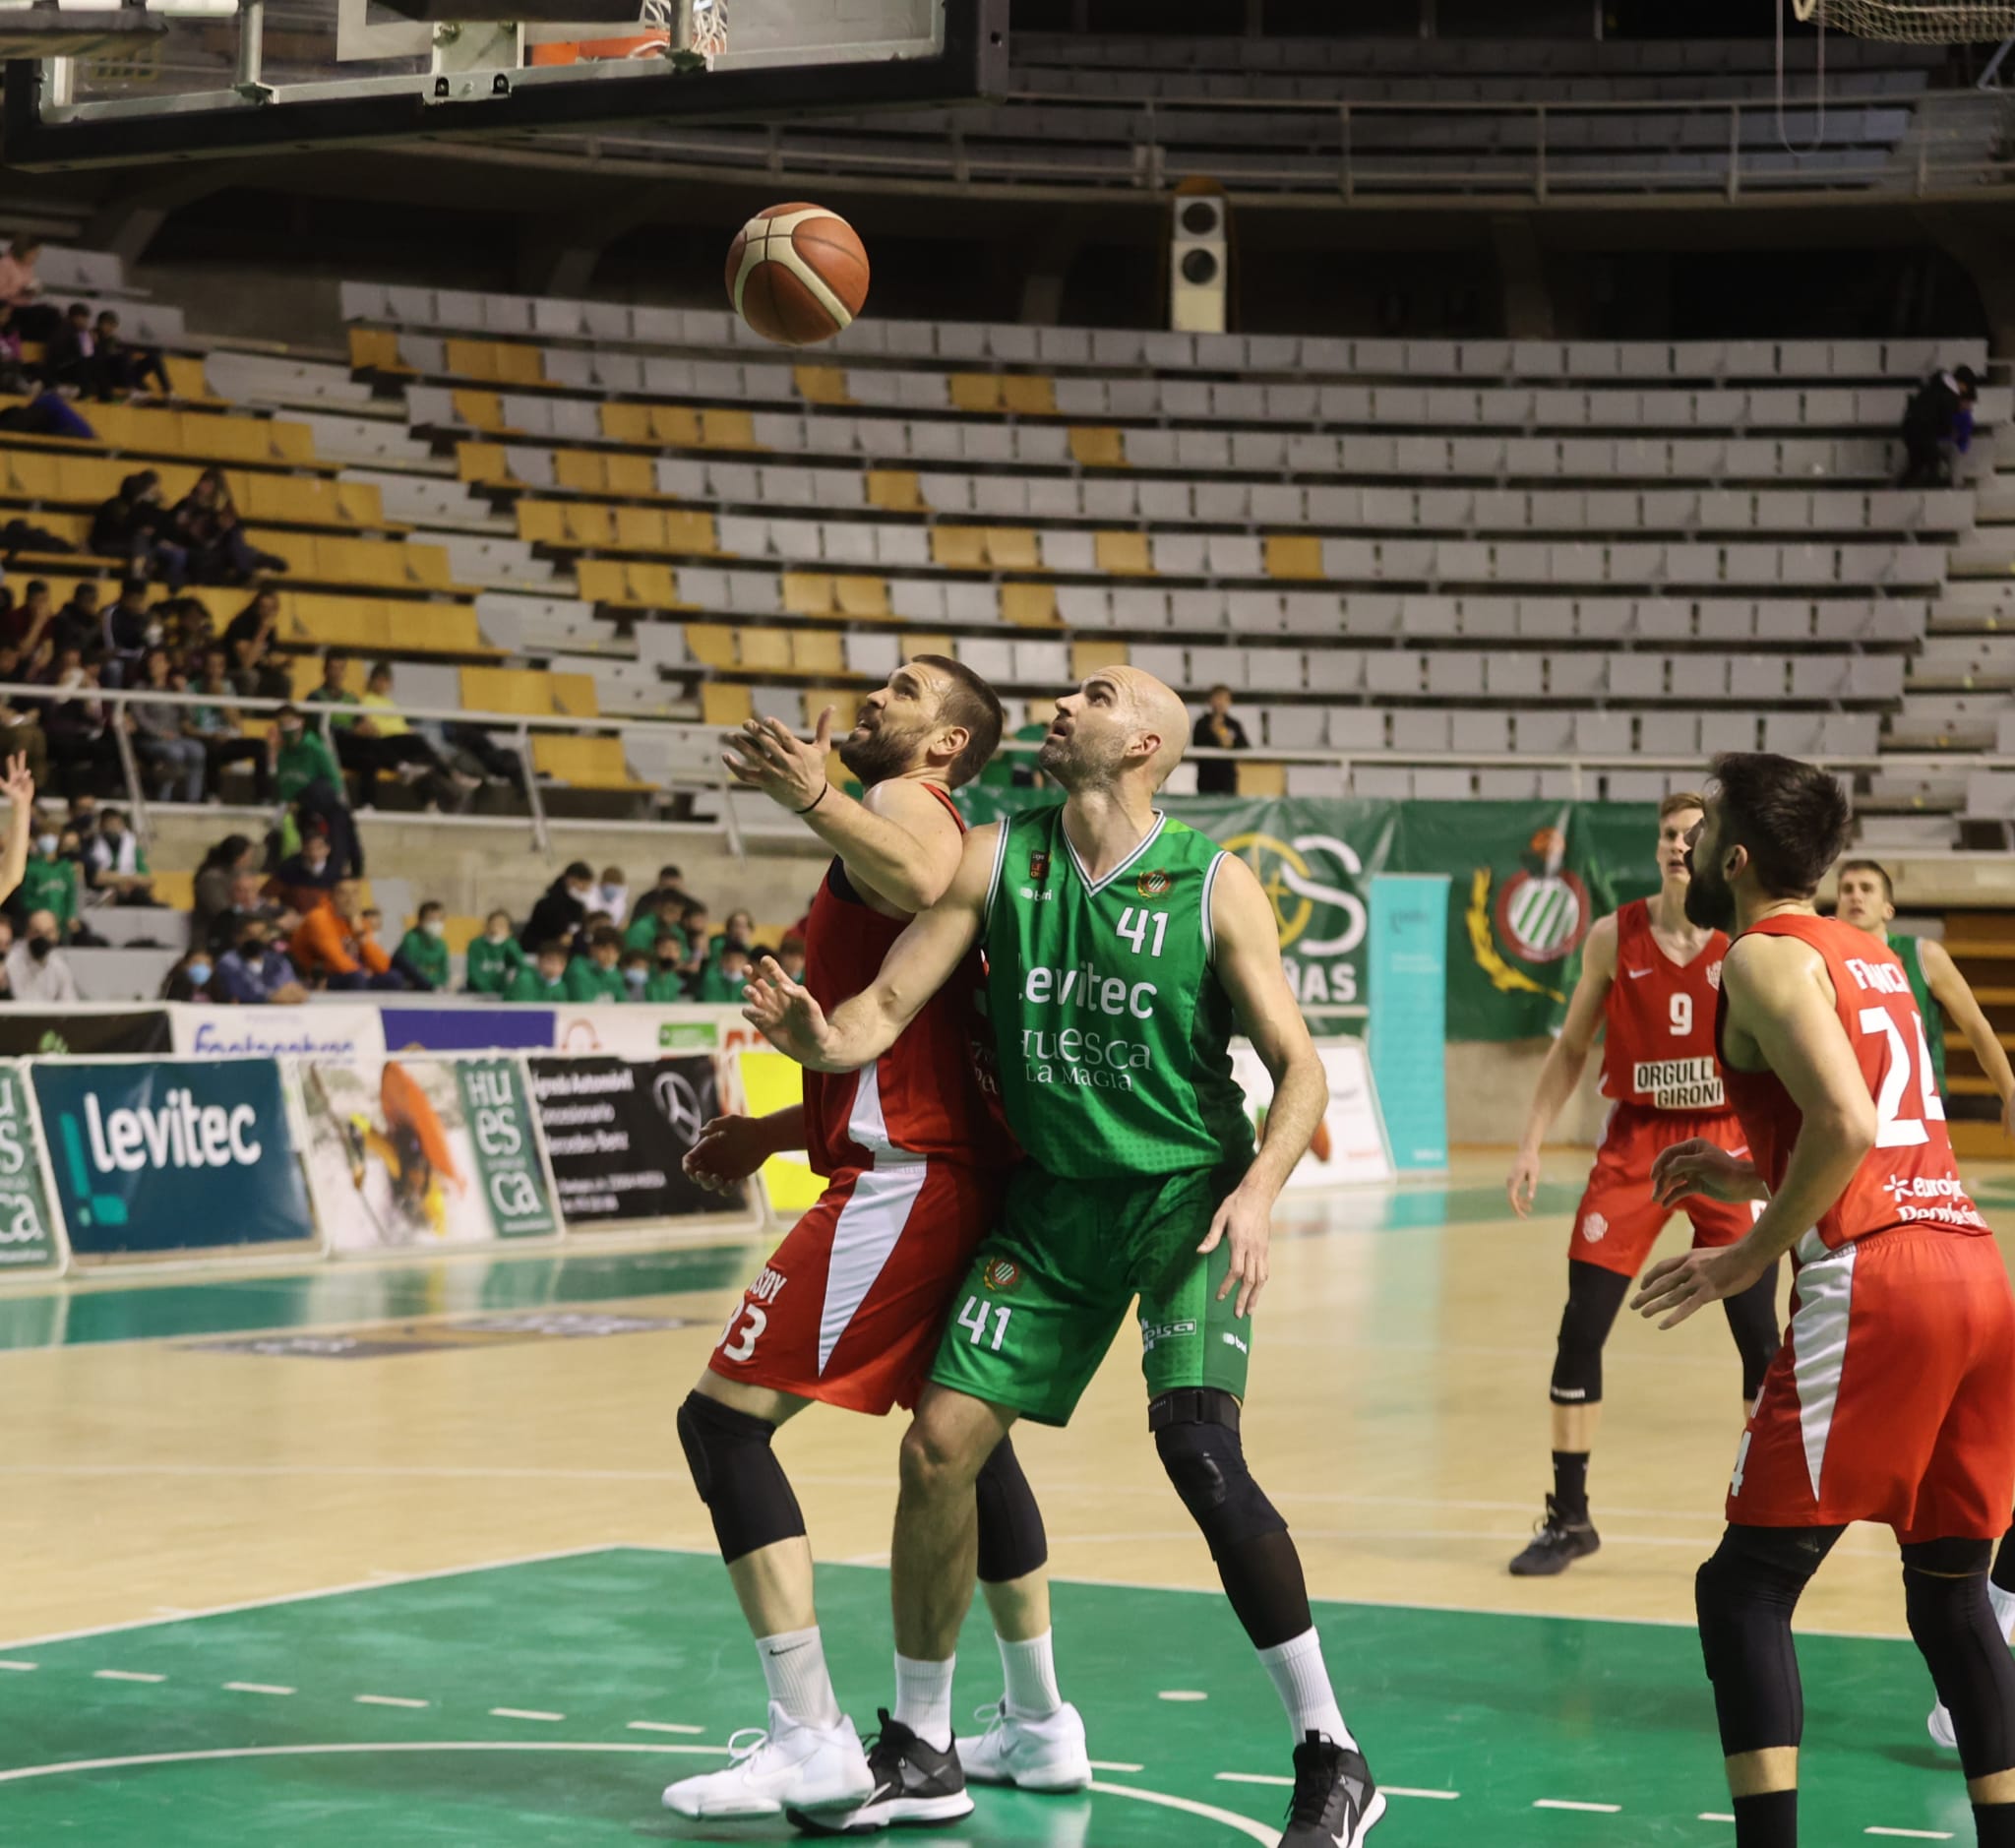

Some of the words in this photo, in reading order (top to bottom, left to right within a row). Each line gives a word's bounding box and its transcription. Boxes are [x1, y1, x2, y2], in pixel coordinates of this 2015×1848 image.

[1116, 907, 1169, 957] 41
[1019, 955, 1158, 1018] evitec
[1670, 993, 1693, 1036] 9
[1637, 1059, 1712, 1088] ORGULL
[84, 1087, 262, 1172] levitec
[956, 1295, 1012, 1351] 41
